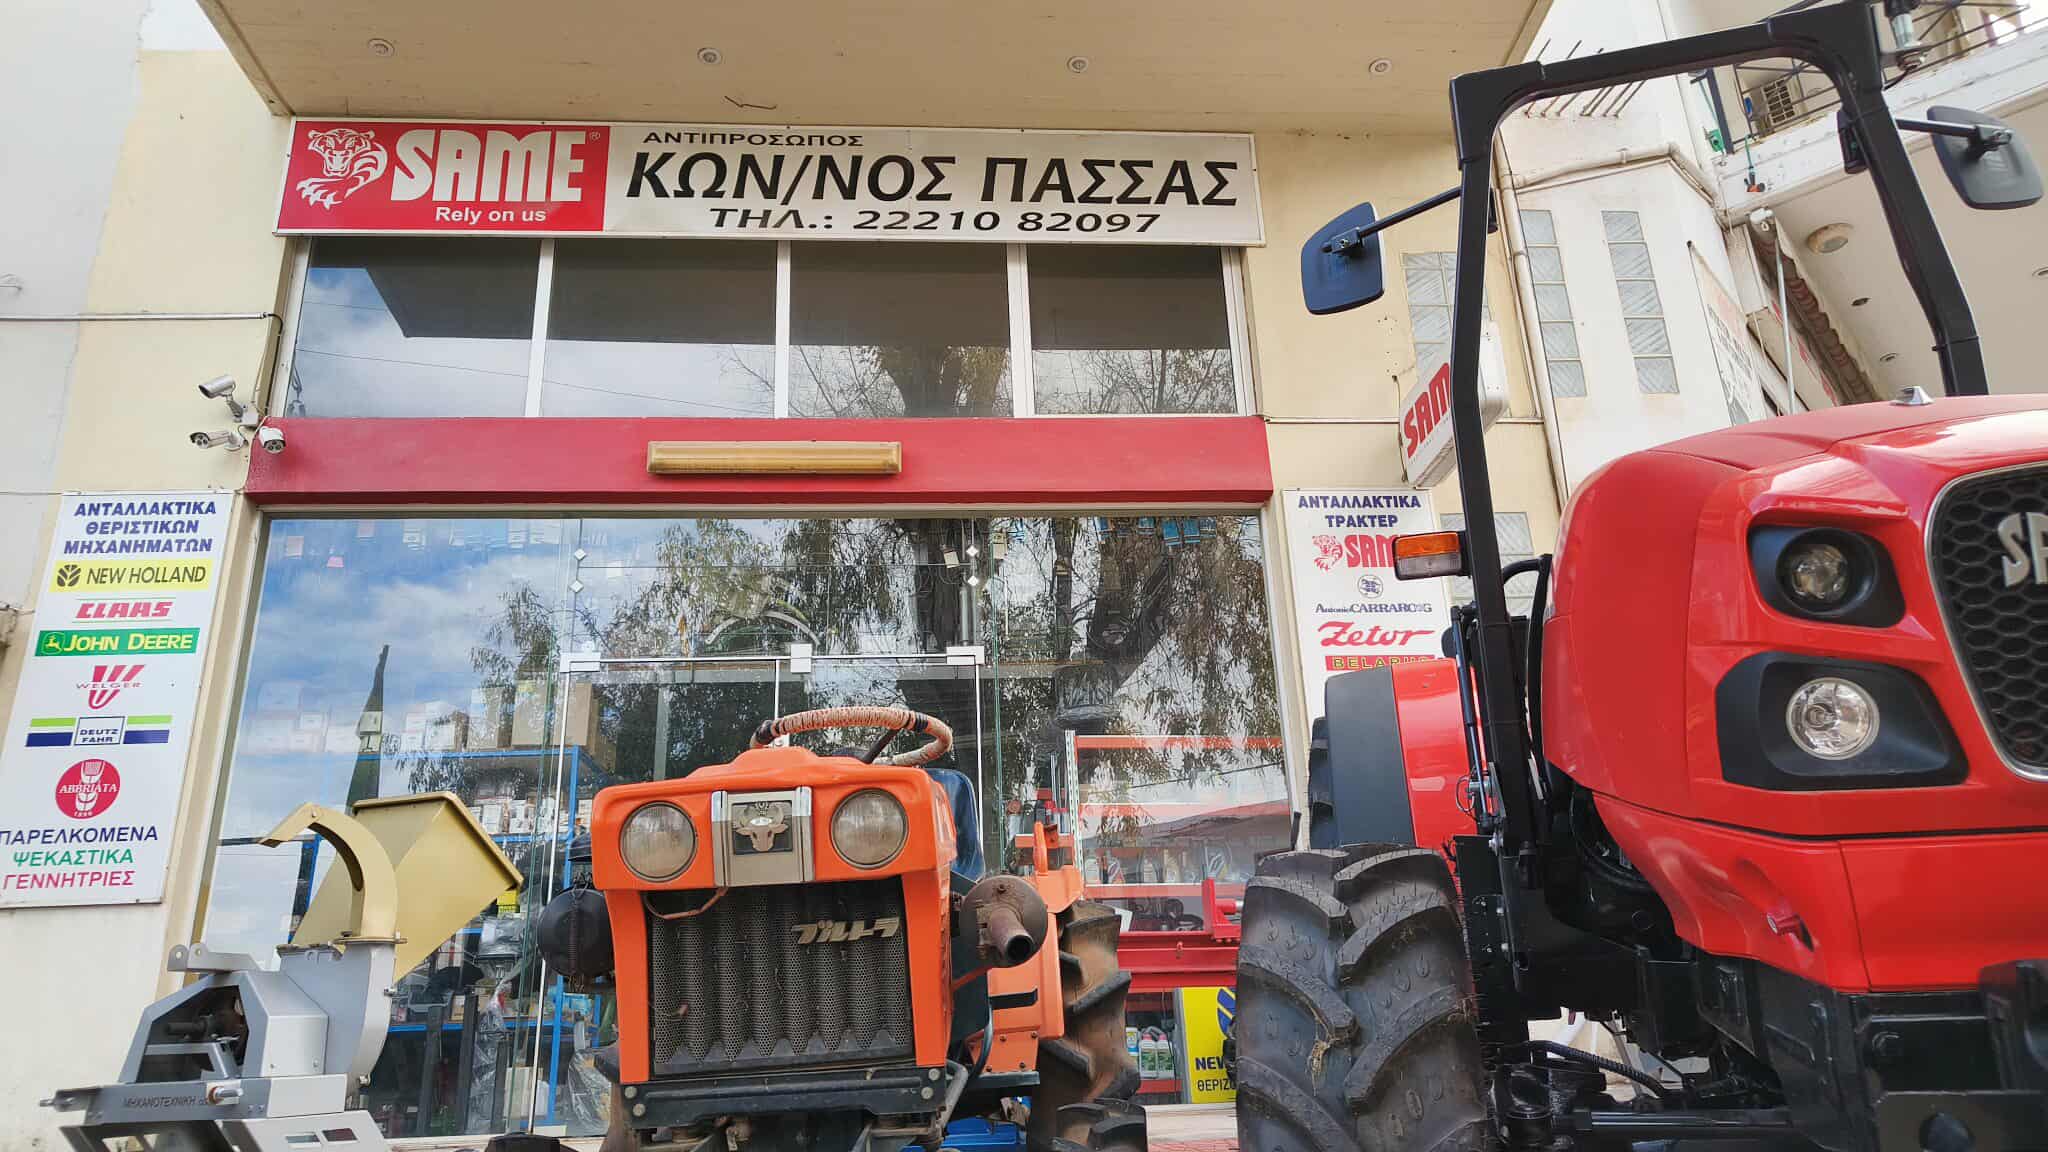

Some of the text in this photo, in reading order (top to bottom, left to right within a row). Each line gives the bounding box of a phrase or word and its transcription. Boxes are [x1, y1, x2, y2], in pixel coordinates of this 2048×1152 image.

[643, 132, 864, 148] ΑΝΤΙΠΡΟΣΩΠΟΣ
[391, 129, 586, 202] SAME
[625, 151, 1238, 206] ΚΩΝ/ΝΟΣ ΠΑΣΣΑΣ
[435, 207, 547, 225] Rely on us
[710, 208, 1161, 233] ΤΗΛ.: 22210 82097
[1404, 362, 1450, 459] SAM
[74, 501, 216, 517] ΑΝΤΑΛΛΑΚΤΙΚΑ
[1298, 495, 1422, 509] ΑΝΤΑΛΛΑΚΤΙΚΑ
[85, 520, 199, 535] ΘΕΡΙΣΤΙΚΩΝ
[1325, 515, 1398, 528] ΤΡΑΚΤΕΡ
[63, 538, 213, 555] ΜΗΧΑΝΗΜΑΤΩΝ
[1344, 534, 1394, 568] SAM
[86, 566, 206, 585] NEW HOLLAND
[75, 601, 173, 619] CLAAS
[62, 633, 193, 652] JOHN DEERE
[1317, 621, 1436, 647] Zetor
[79, 728, 119, 736] DEUTZ
[0, 826, 158, 845] ΠΑΡΕΛΚΟΜΕΝΑ
[13, 848, 134, 867] ΨΕΚΑΣΤΙΚΑ
[3, 871, 135, 890] ΓΕΝΝΗΤΡΙΕΣ
